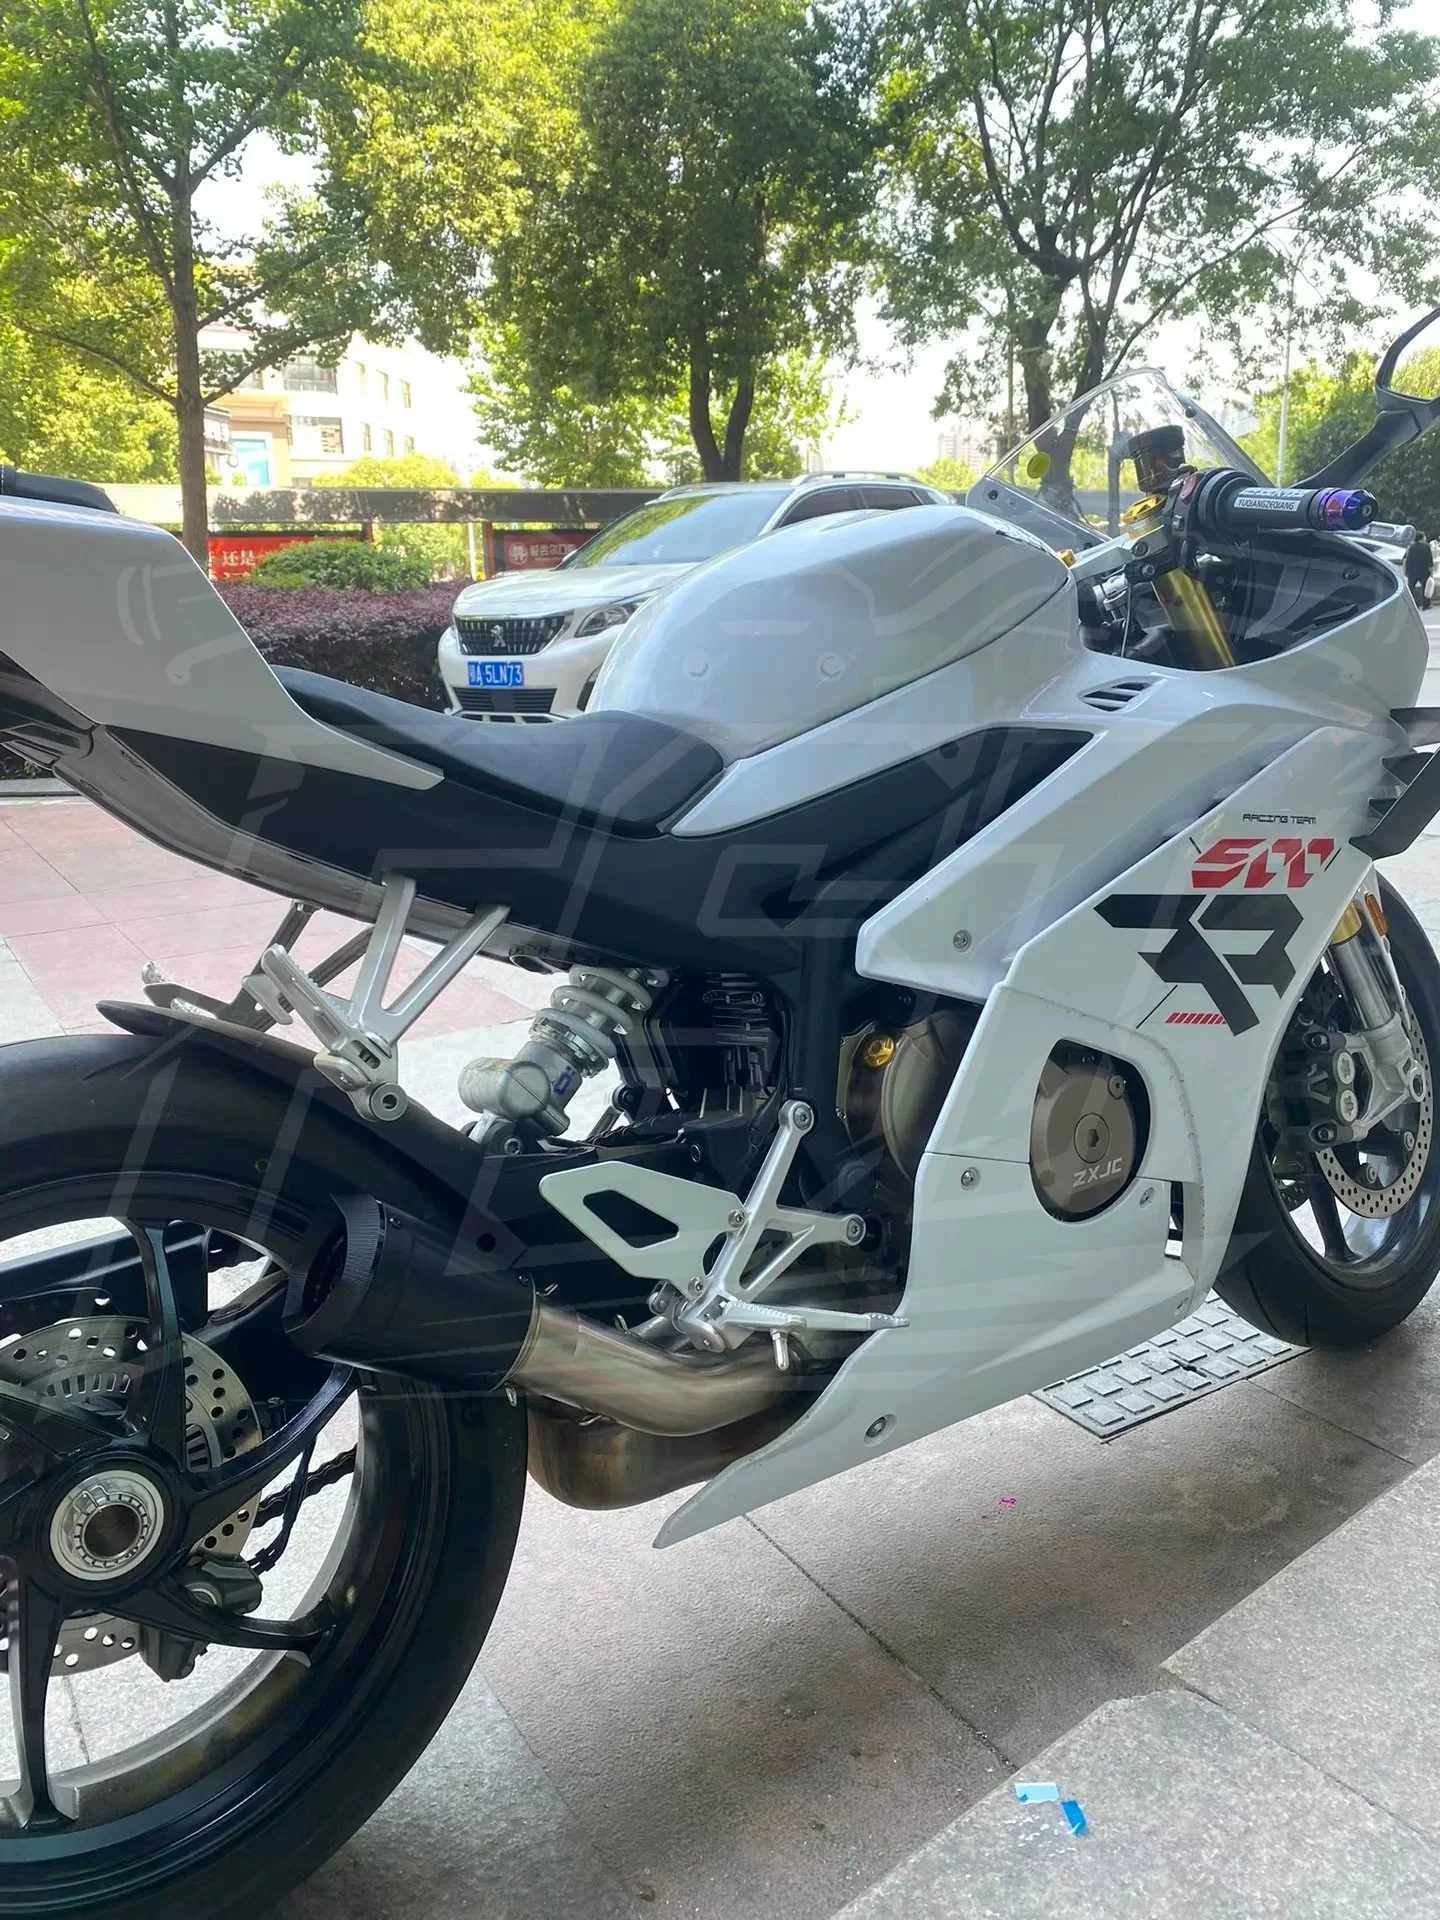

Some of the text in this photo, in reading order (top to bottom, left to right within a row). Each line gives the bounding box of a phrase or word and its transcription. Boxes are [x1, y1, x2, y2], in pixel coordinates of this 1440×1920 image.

[1243, 813, 1317, 825] RACING TEAM
[1191, 837, 1335, 889] 500
[1072, 1157, 1123, 1188] ZXJC
